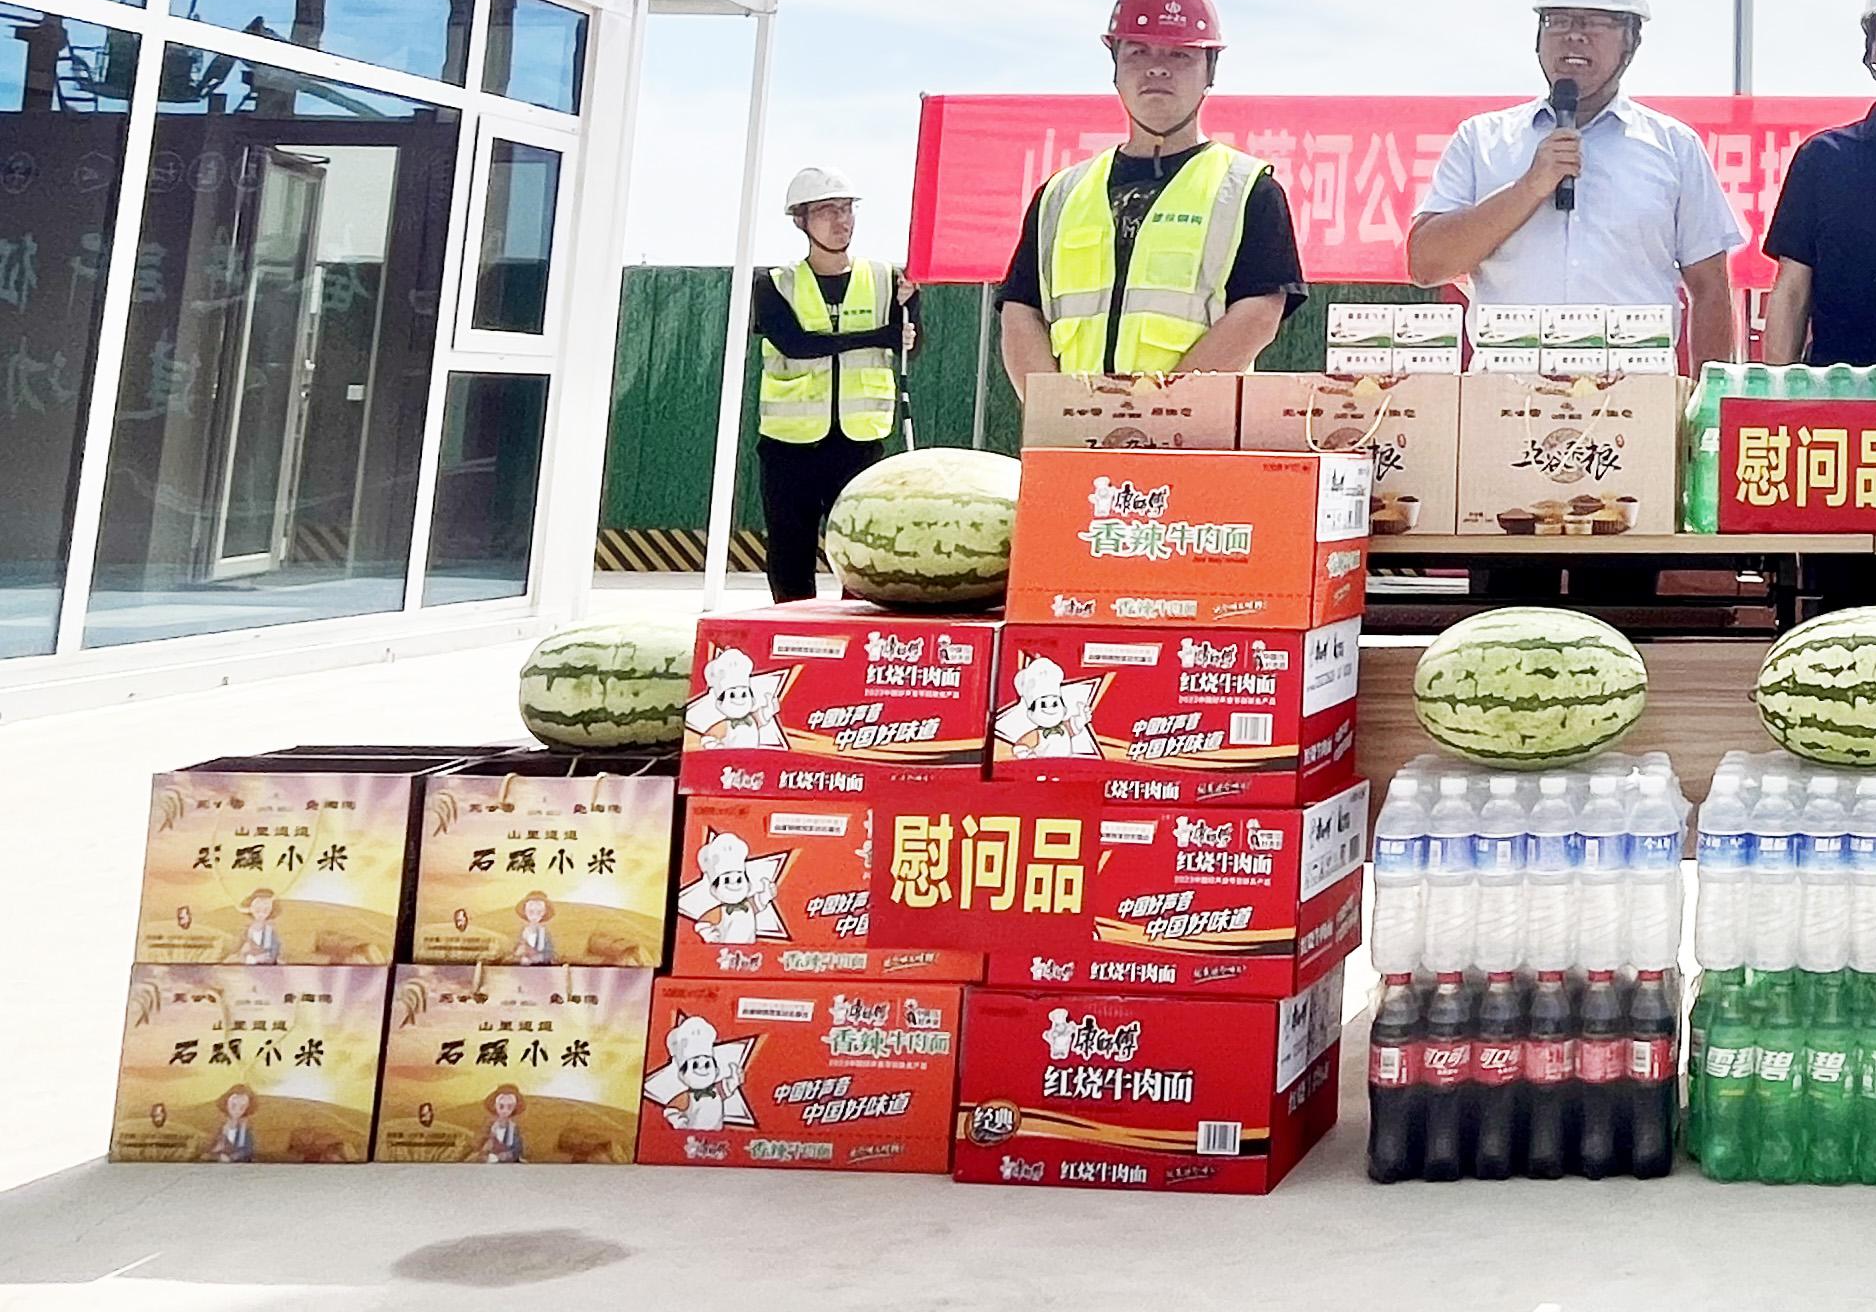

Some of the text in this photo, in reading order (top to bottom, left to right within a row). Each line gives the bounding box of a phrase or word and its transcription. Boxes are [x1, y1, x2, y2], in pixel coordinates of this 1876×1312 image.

[1084, 520, 1253, 559] 香辣牛肉面
[865, 664, 961, 688] 红烧牛肉面
[1179, 672, 1276, 696] 红烧牛肉面
[807, 703, 884, 729] 中国好声音
[1132, 712, 1203, 737] 中国好声音
[834, 719, 941, 751] 中国好味道
[1127, 730, 1226, 761] 中国好味道
[778, 771, 865, 792] 红烧牛肉面
[1104, 780, 1180, 801] 烧牛肉面
[890, 814, 1086, 915] 慰问品
[1175, 851, 1273, 876] 红烧牛肉面
[806, 890, 870, 918] 中国好声
[1117, 890, 1196, 918] 中国好声音
[1145, 906, 1253, 940] 中国好味道
[1089, 961, 1177, 984] 红烧牛肉面
[824, 1027, 950, 1058] 香辣牛肉面
[773, 1076, 852, 1102] 中国好声音
[1043, 1065, 1194, 1103] 红烧牛肉面
[801, 1091, 911, 1126] 中国好味道
[972, 1106, 1015, 1133] 经典
[1060, 1161, 1148, 1184] 红烧牛肉面
